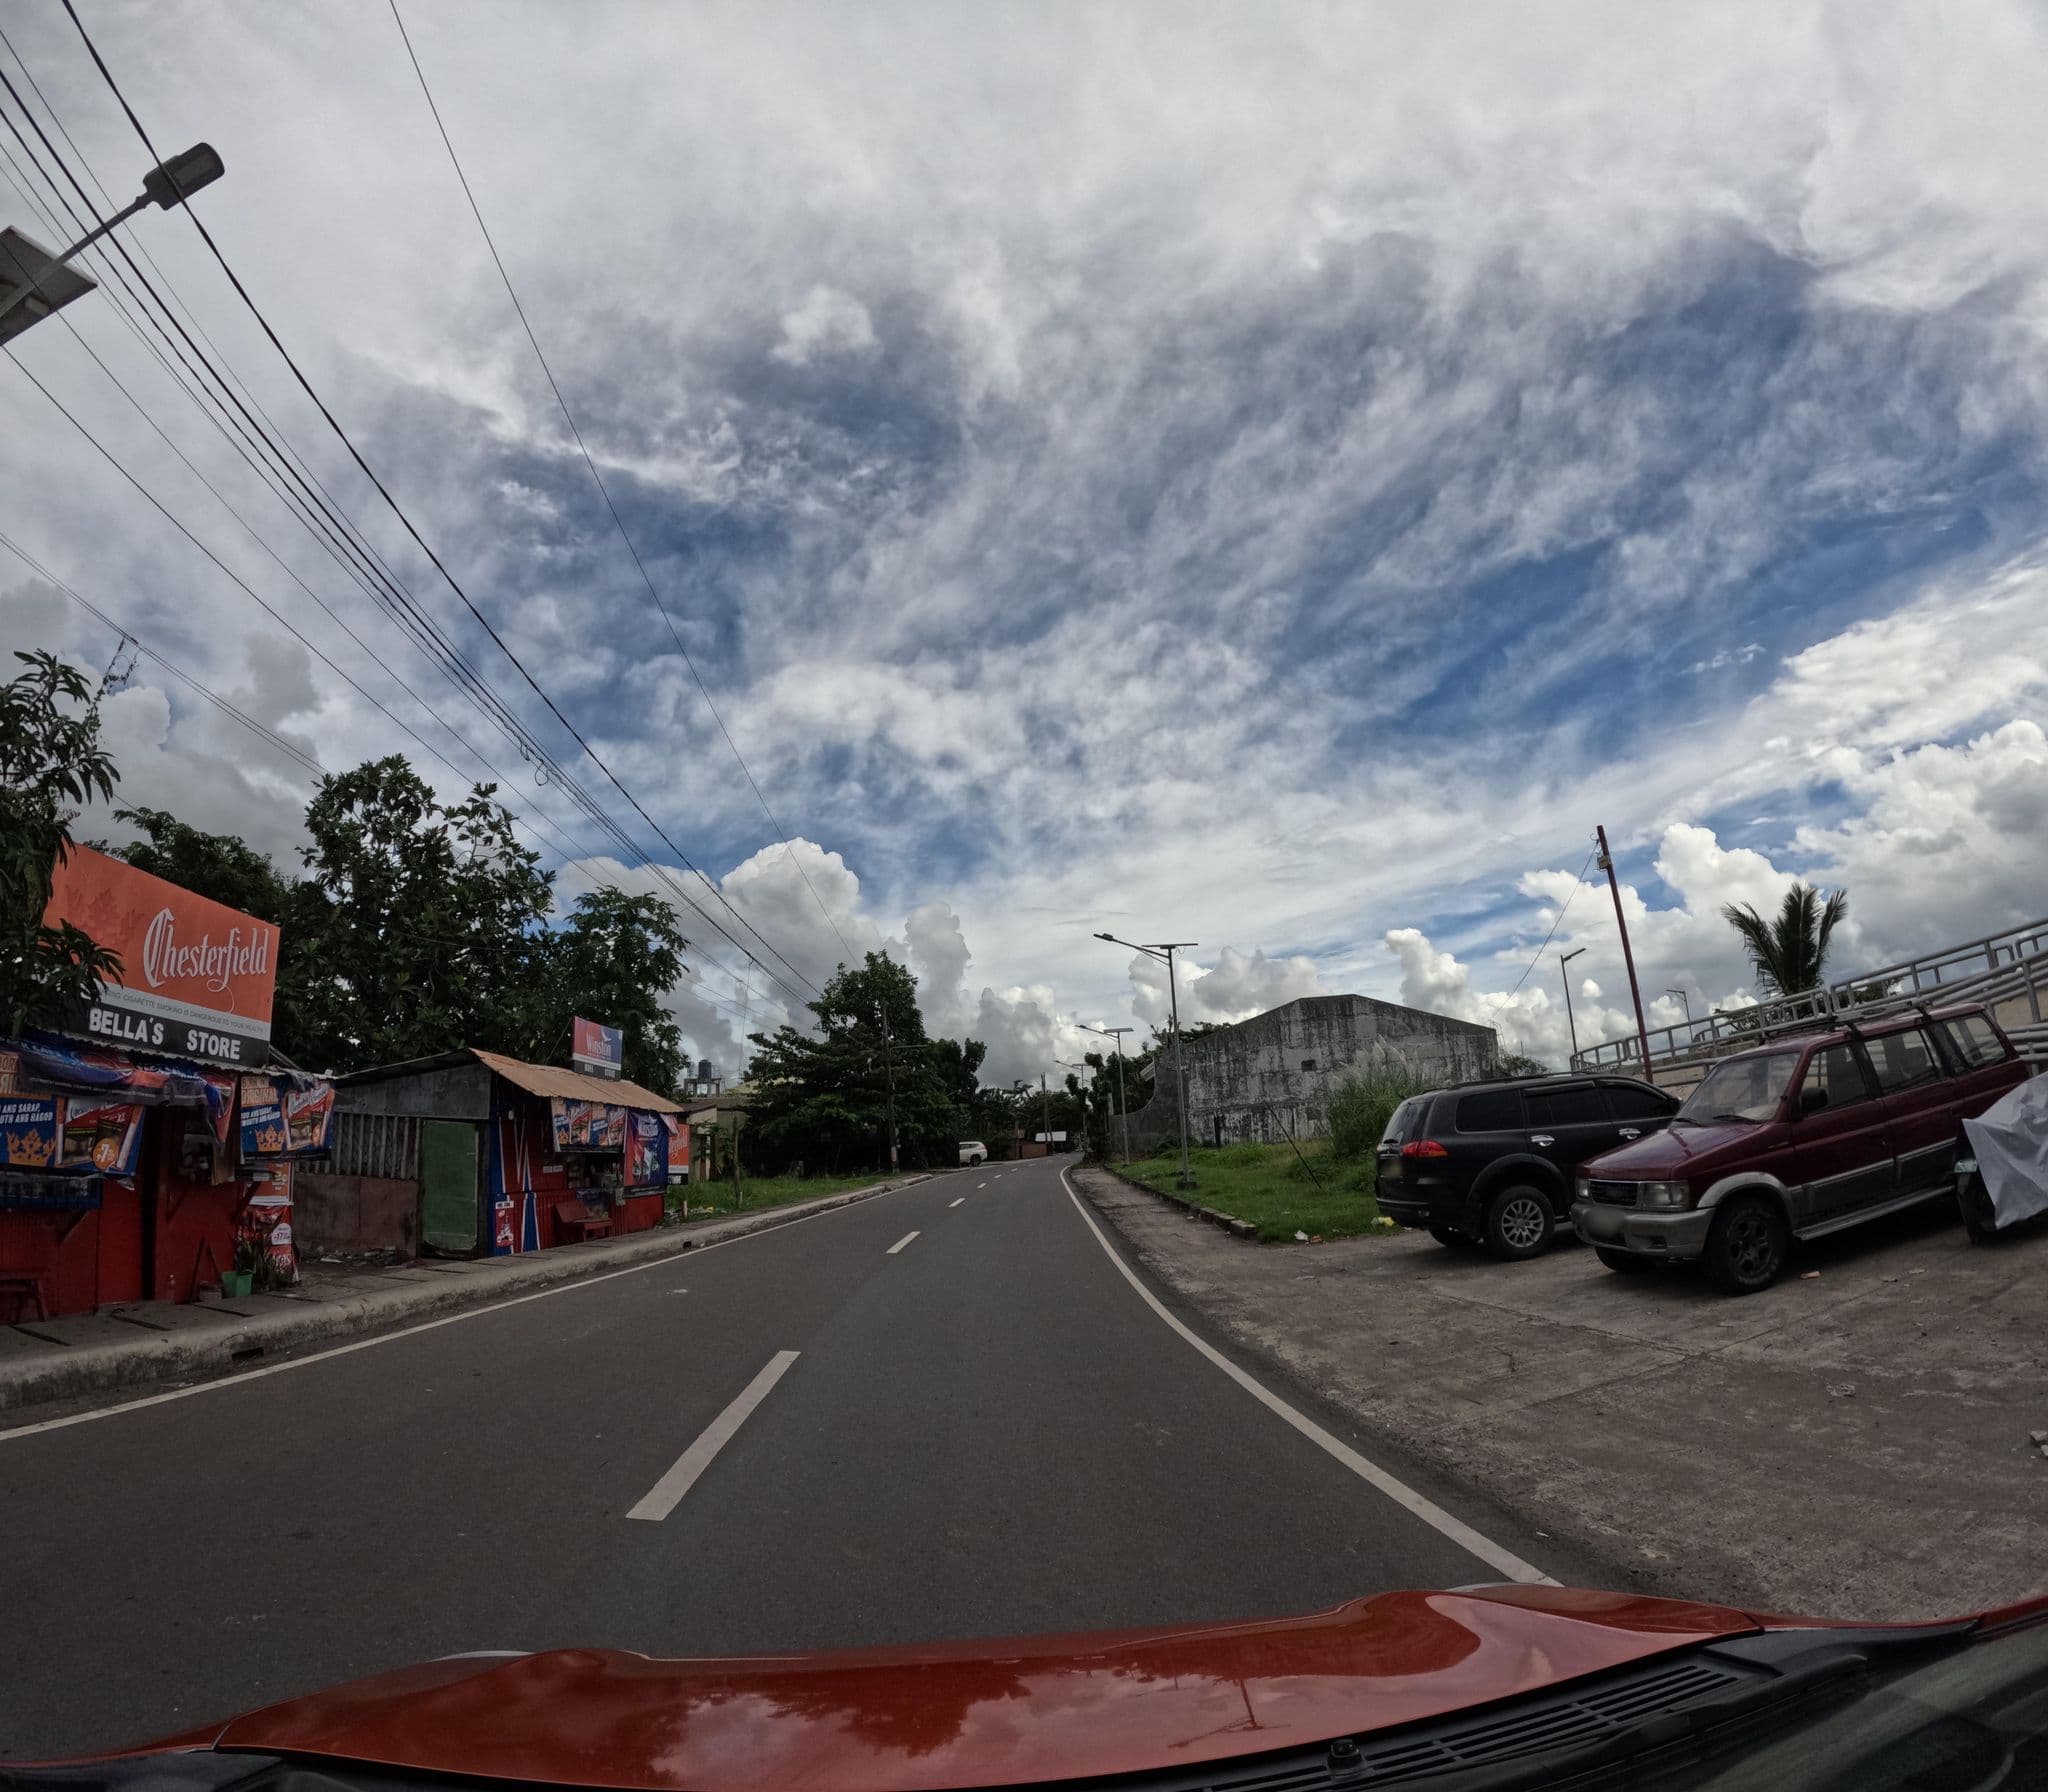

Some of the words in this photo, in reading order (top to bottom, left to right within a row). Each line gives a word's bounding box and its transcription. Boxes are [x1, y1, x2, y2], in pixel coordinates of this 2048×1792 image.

[143, 907, 269, 992] Chesterfield
[88, 1006, 165, 1046] BELLA'S
[186, 1029, 241, 1060] STORE
